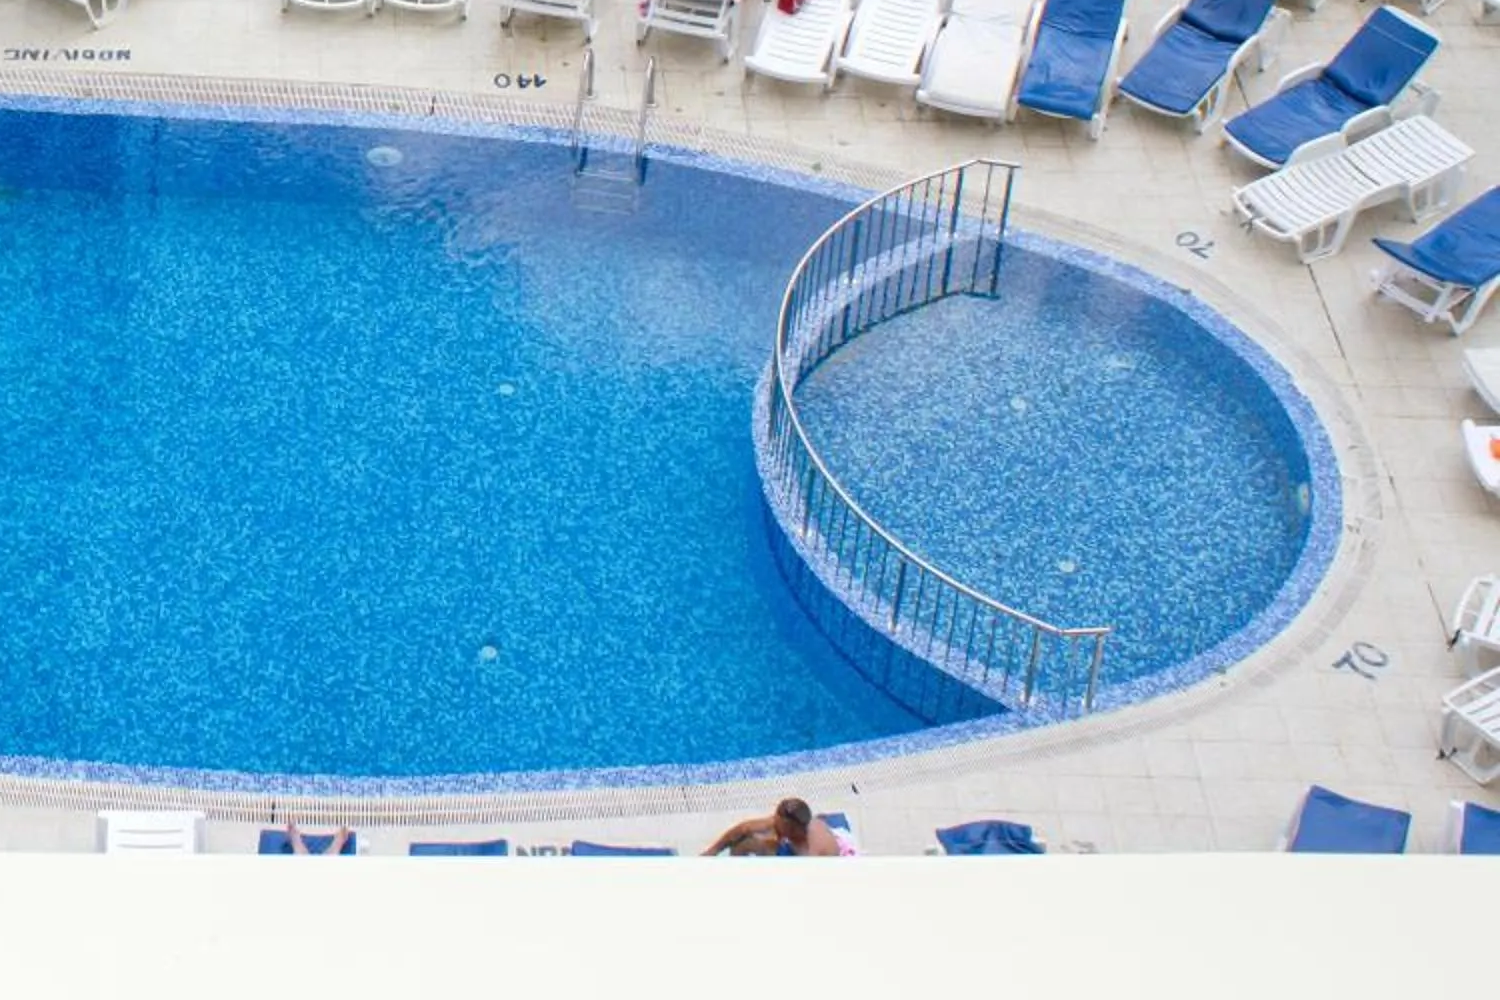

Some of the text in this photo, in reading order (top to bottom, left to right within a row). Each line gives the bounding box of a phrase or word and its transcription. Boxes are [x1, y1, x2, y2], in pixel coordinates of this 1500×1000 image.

[493, 72, 547, 89] 140
[1175, 231, 1215, 260] 70
[1331, 641, 1389, 681] 70
